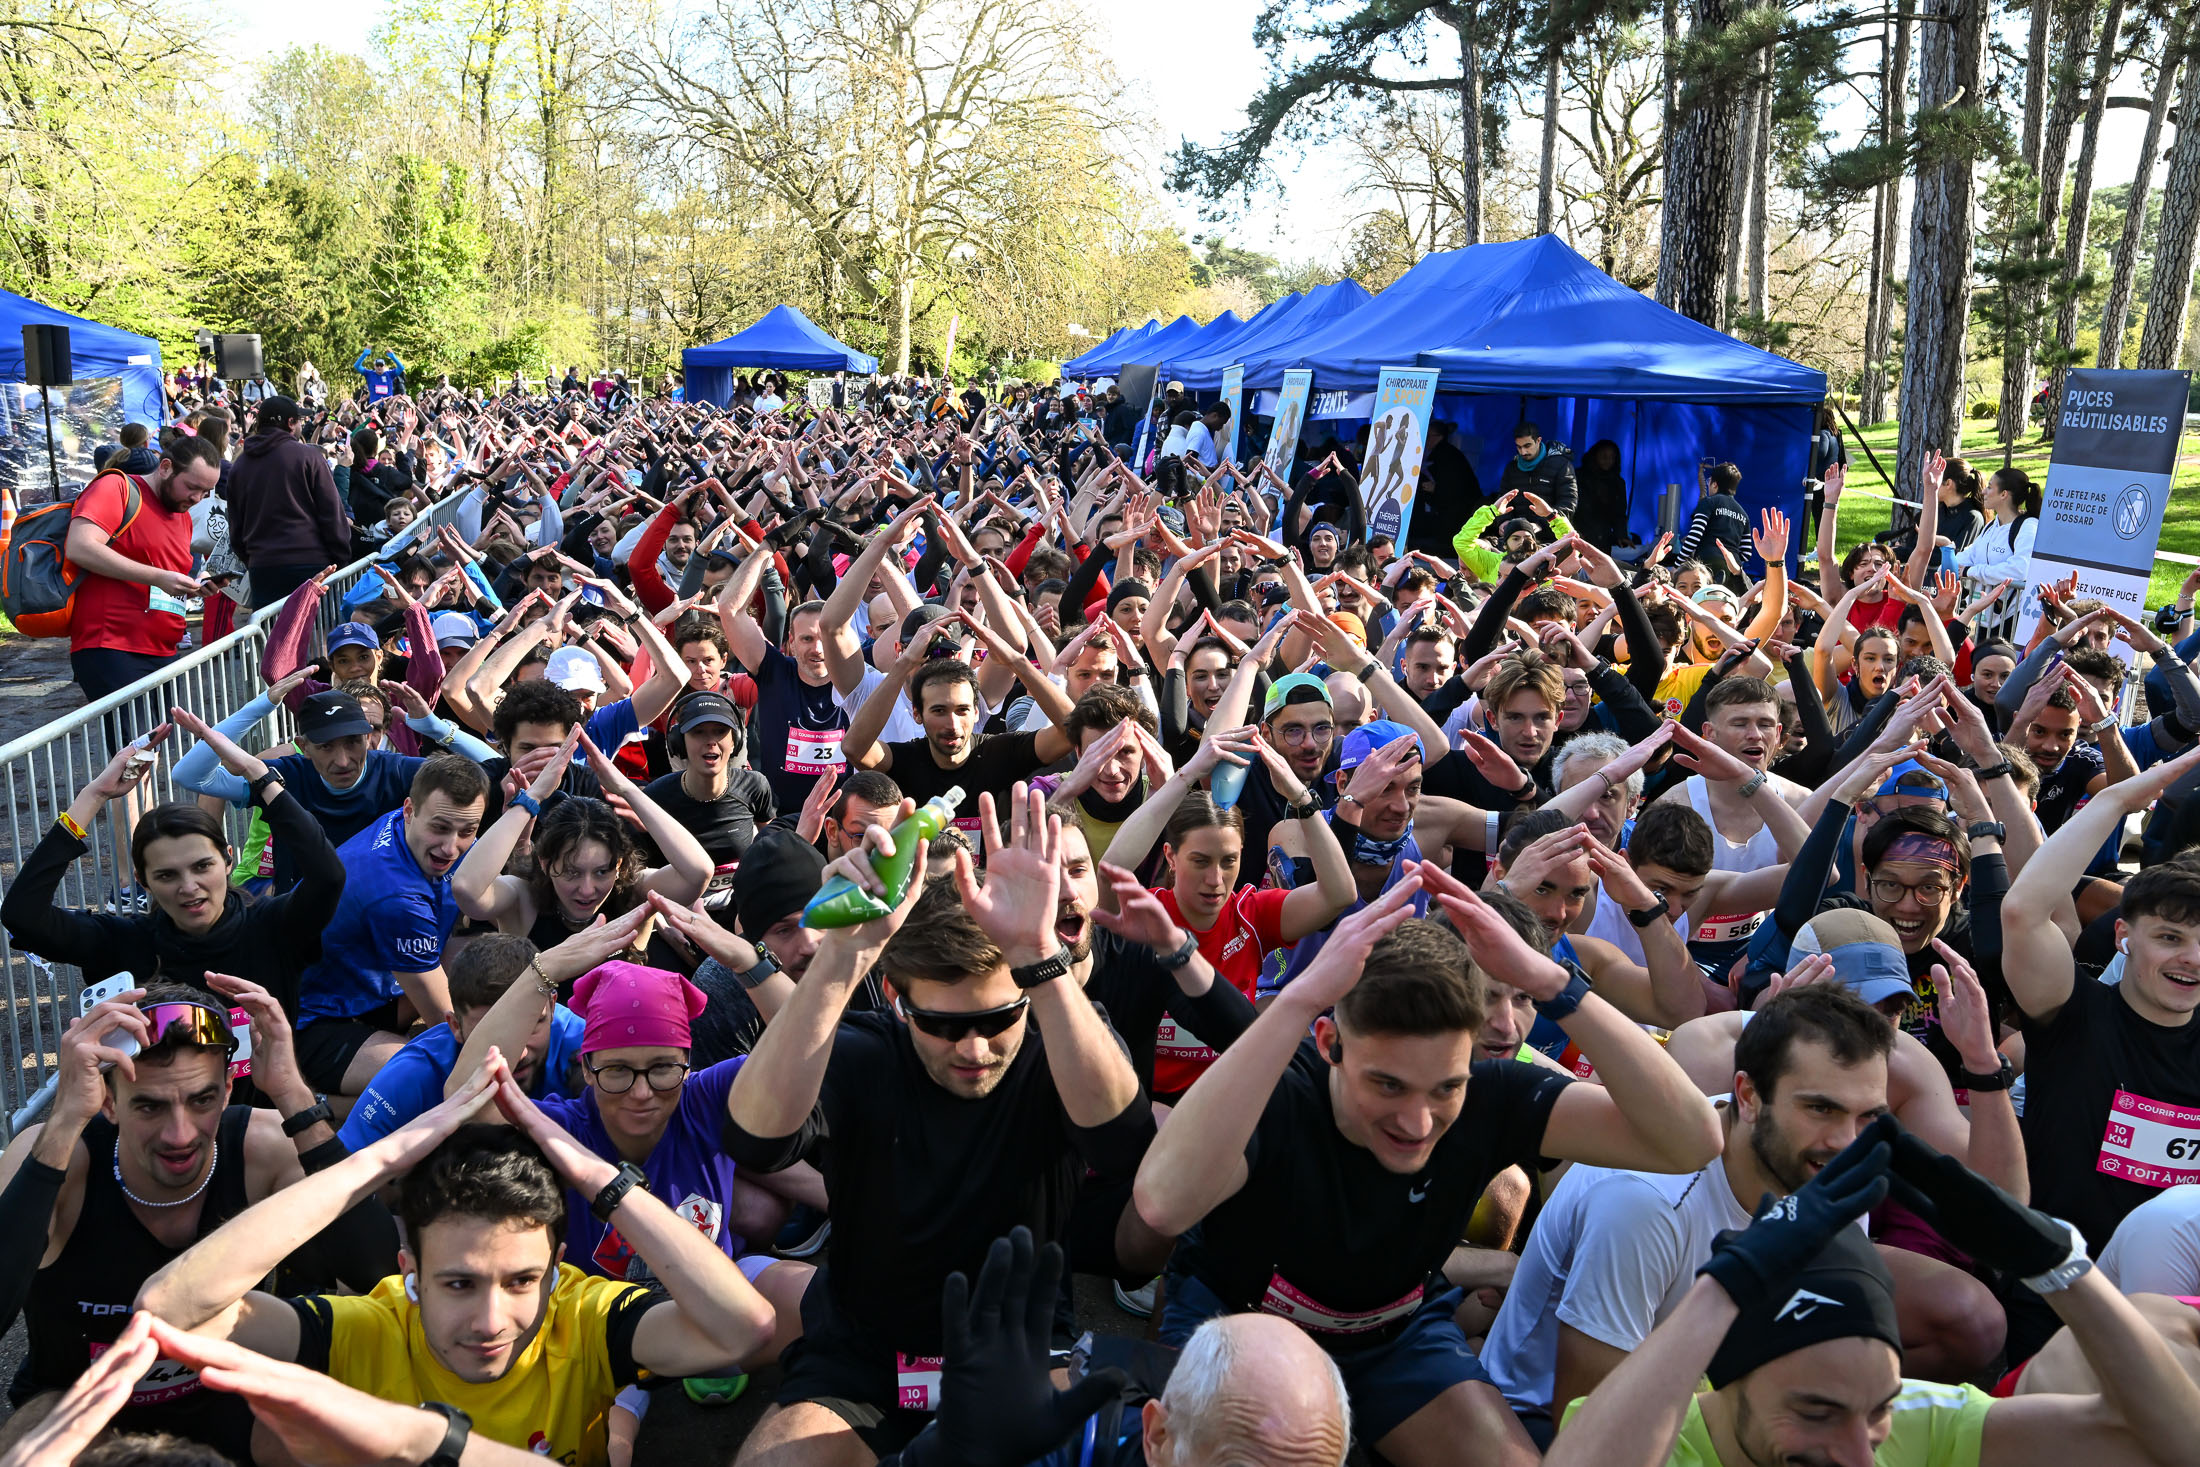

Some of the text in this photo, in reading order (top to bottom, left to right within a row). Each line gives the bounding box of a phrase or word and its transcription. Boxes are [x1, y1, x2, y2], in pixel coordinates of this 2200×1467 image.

[1386, 378, 1428, 389] CHIROPRAXIE
[1382, 388, 1427, 406] & SPORT
[2066, 390, 2114, 408] PUCES
[2062, 406, 2168, 434] RÉUTILISABLES
[2053, 488, 2107, 503] NE JETEZ PAS
[2047, 499, 2109, 516] VOTRE PUCE DE
[2055, 512, 2094, 526] DOSSARD
[1376, 522, 1398, 533] MANUELLE
[2090, 585, 2115, 598] VOTRE
[2115, 590, 2139, 603] PUCE
[813, 747, 833, 760] 23
[814, 764, 820, 773] À
[1728, 917, 1761, 938] 586
[1174, 1050, 1199, 1058] TOIT
[1200, 1048, 1209, 1058] À
[1574, 1069, 1589, 1077] KM
[382, 1100, 397, 1116] FOOD
[2137, 1102, 2175, 1118] COURIR
[2114, 1125, 2127, 1135] 10
[2108, 1133, 2128, 1146] KM
[2126, 1164, 2198, 1184] TOIT À MOI
[921, 1356, 943, 1365] COU
[165, 1389, 177, 1399] À
[906, 1388, 920, 1399] 10
[904, 1400, 924, 1409] KM
